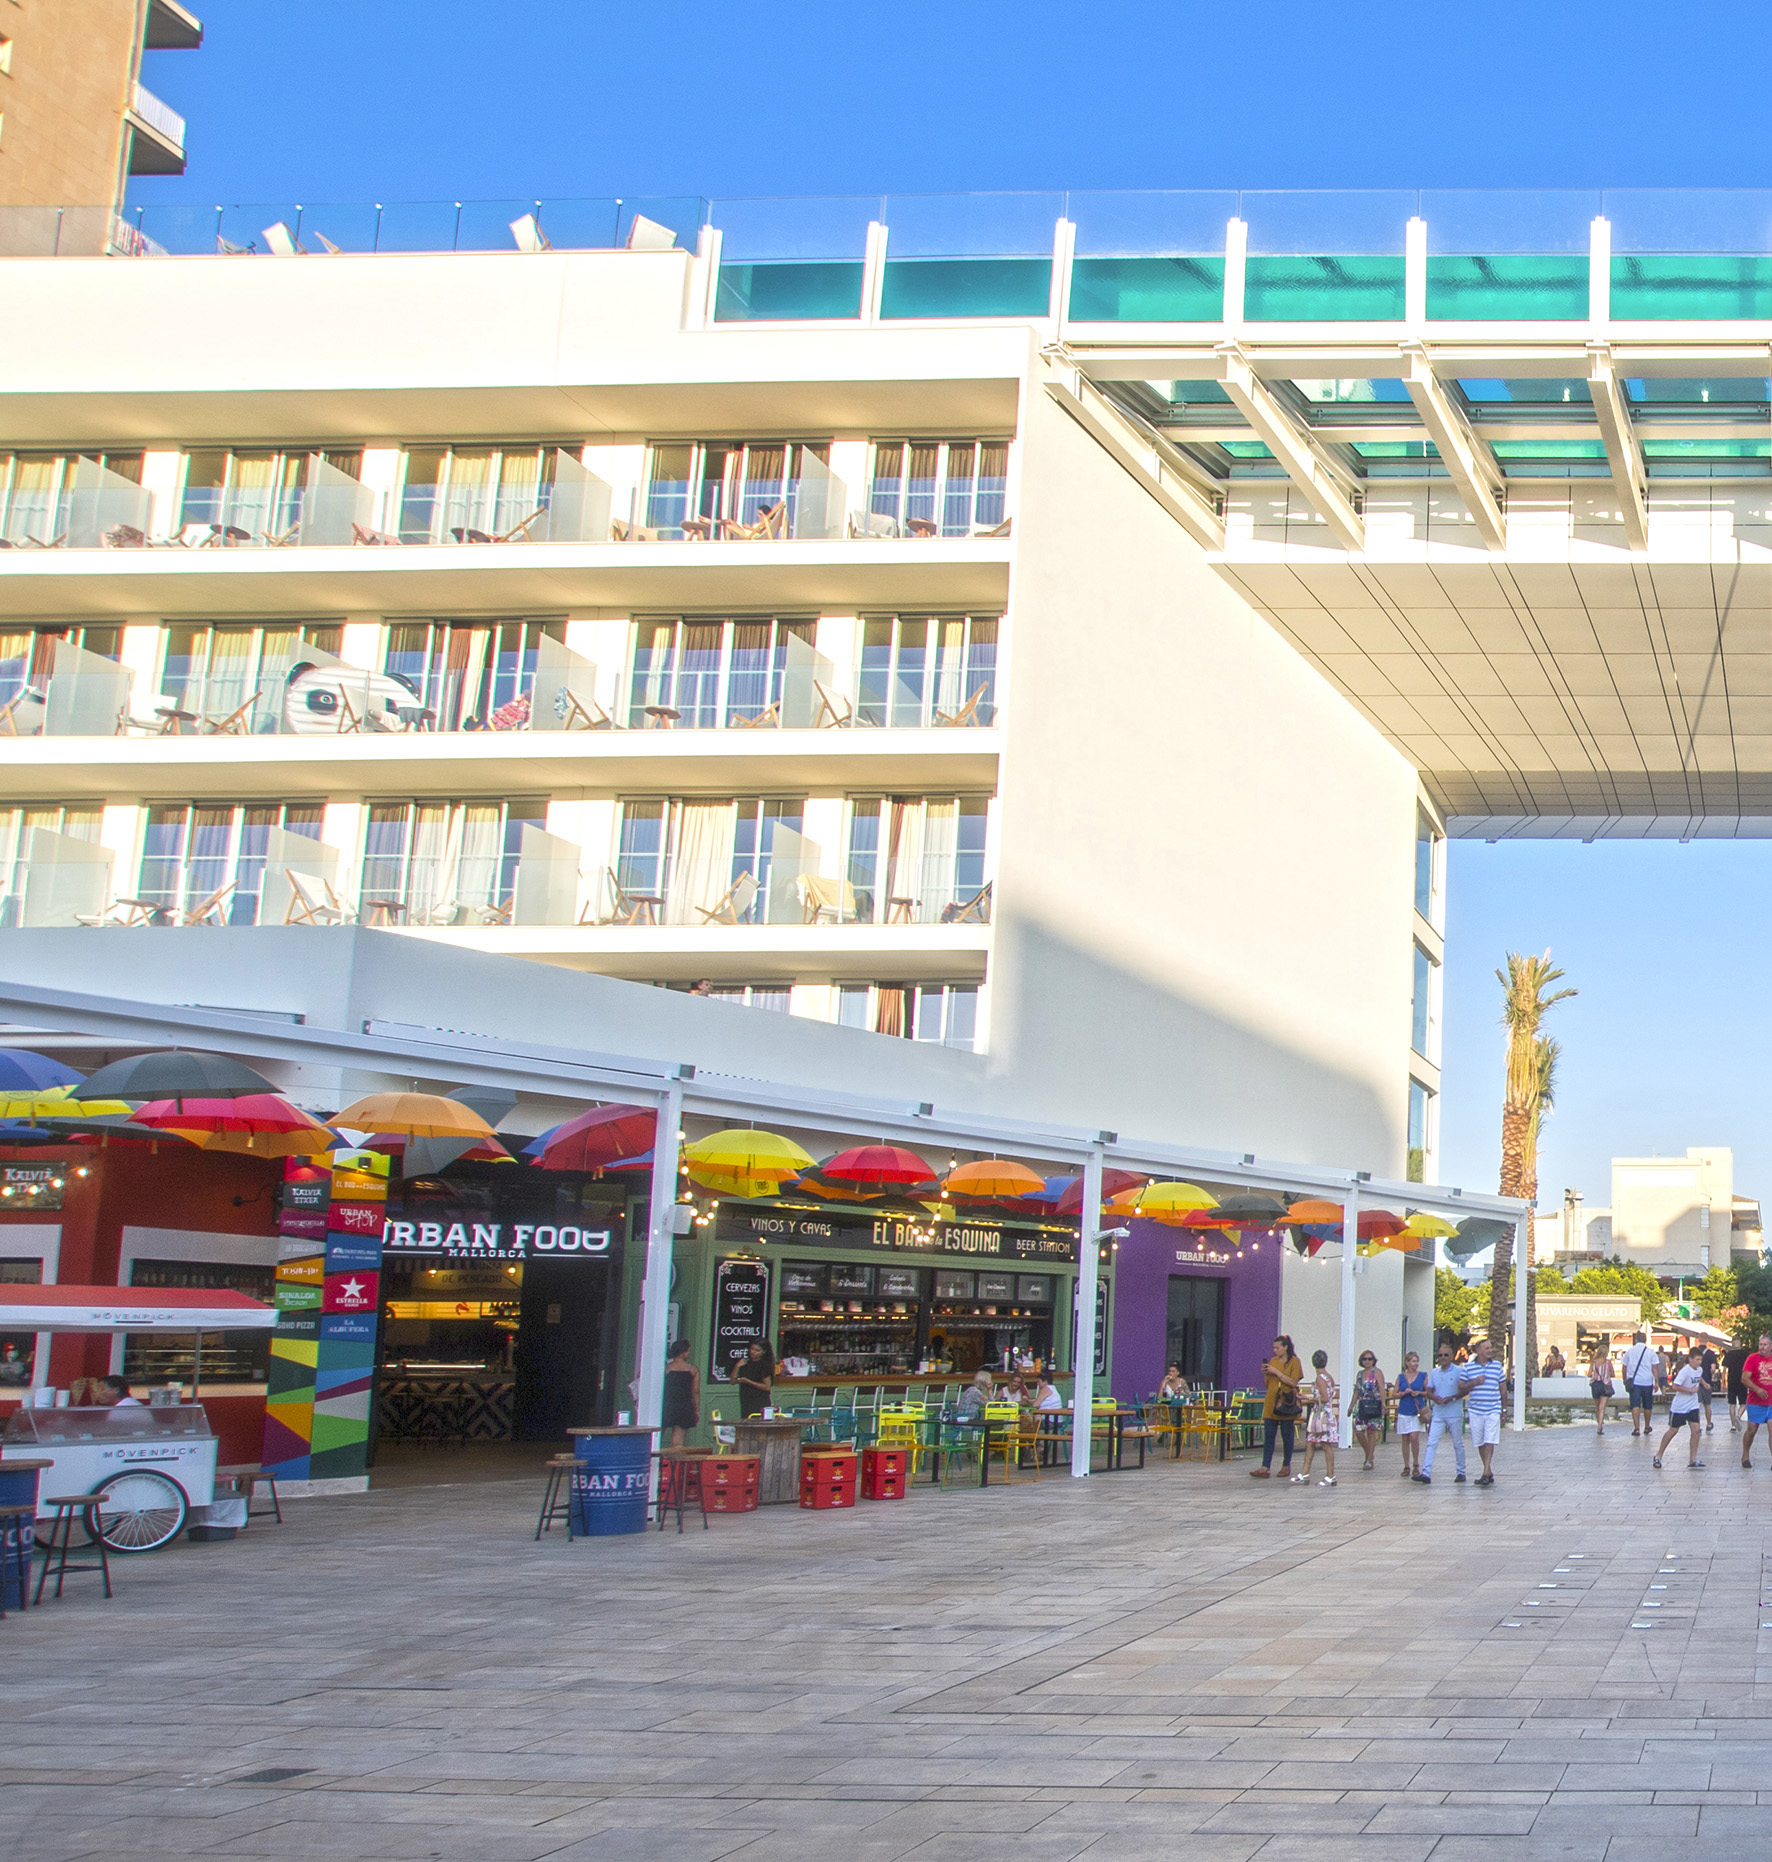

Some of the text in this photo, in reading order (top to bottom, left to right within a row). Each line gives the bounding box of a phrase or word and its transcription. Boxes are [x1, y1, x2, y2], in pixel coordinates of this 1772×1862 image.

[340, 1208, 372, 1217] URBAN
[751, 1218, 832, 1235] VINOS Y CAVAS
[513, 1224, 611, 1250] FOOD
[873, 1221, 890, 1245] EL
[945, 1227, 1000, 1253] ESQUINA
[1016, 1238, 1070, 1254] BEER STATION
[448, 1248, 527, 1258] MALLORCA
[1176, 1250, 1205, 1262] URBAN
[725, 1283, 760, 1293] CERVEZAS
[730, 1304, 753, 1314] VINOS
[1540, 1307, 1628, 1317] RIVARENO GELATO
[720, 1326, 760, 1337] COCKTAILS
